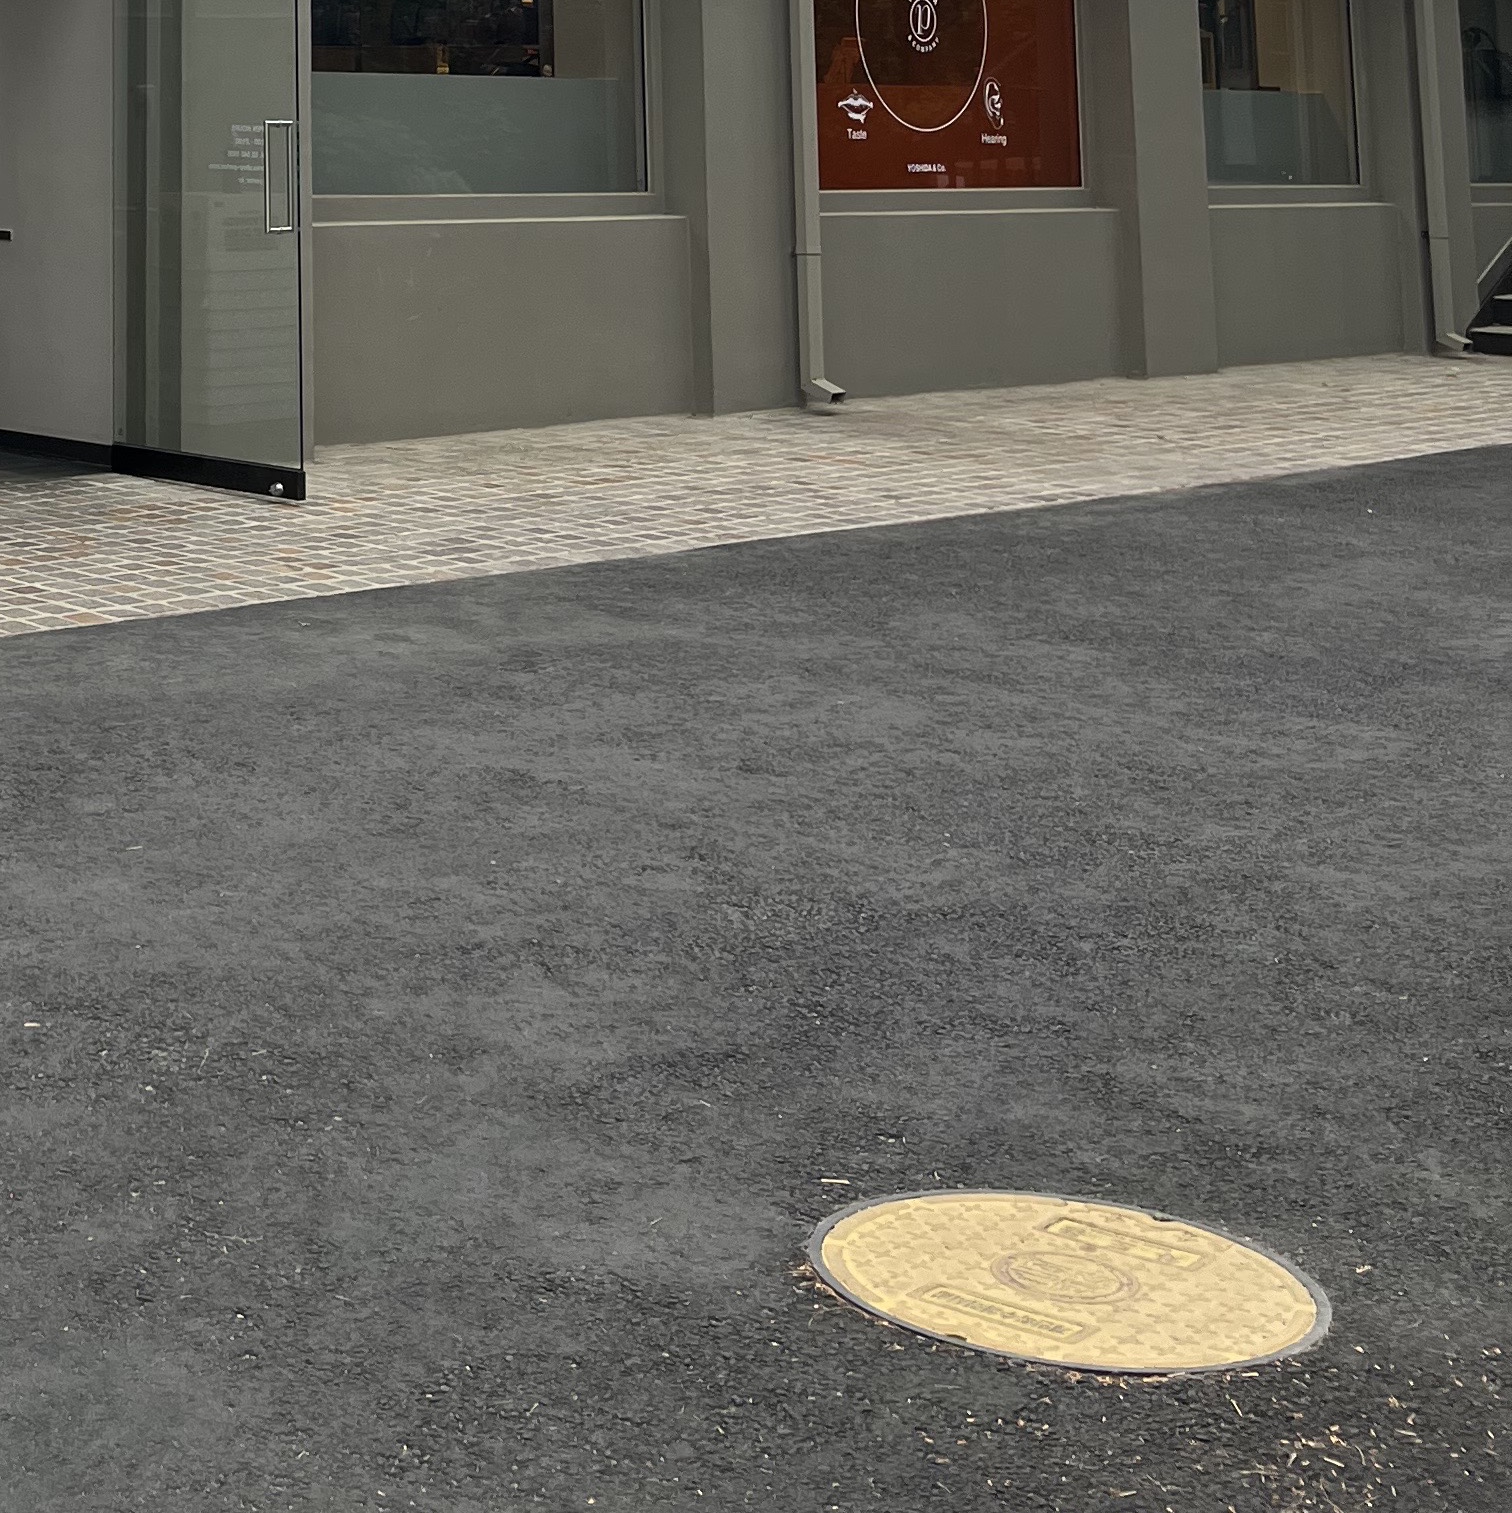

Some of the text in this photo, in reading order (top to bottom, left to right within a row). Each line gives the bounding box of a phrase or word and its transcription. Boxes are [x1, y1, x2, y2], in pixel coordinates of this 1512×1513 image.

[847, 128, 868, 140] Taste
[981, 133, 1007, 147] Hearing
[907, 163, 932, 173] YOSHIDA
